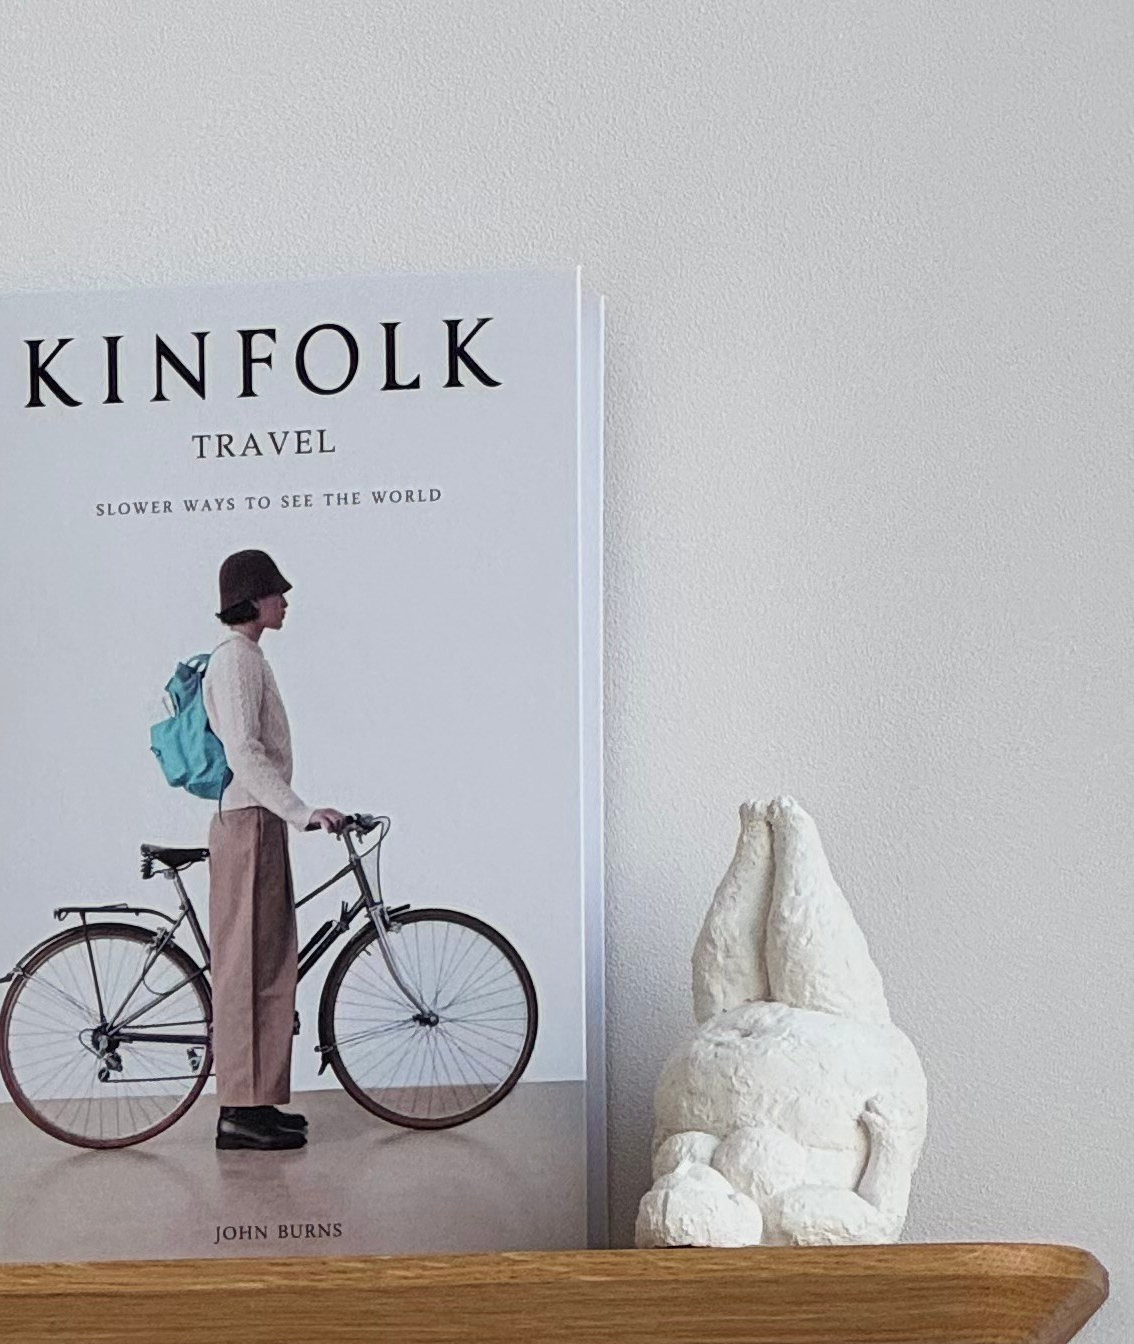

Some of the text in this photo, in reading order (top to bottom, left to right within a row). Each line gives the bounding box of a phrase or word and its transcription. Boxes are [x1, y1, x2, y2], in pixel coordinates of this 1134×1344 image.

[23, 317, 503, 409] KINFOLK
[191, 428, 336, 460] TRAVEL
[95, 488, 442, 517] SLOWER WAYS TO SEE THE WORLD
[213, 1222, 343, 1245] JOHN BURNS
